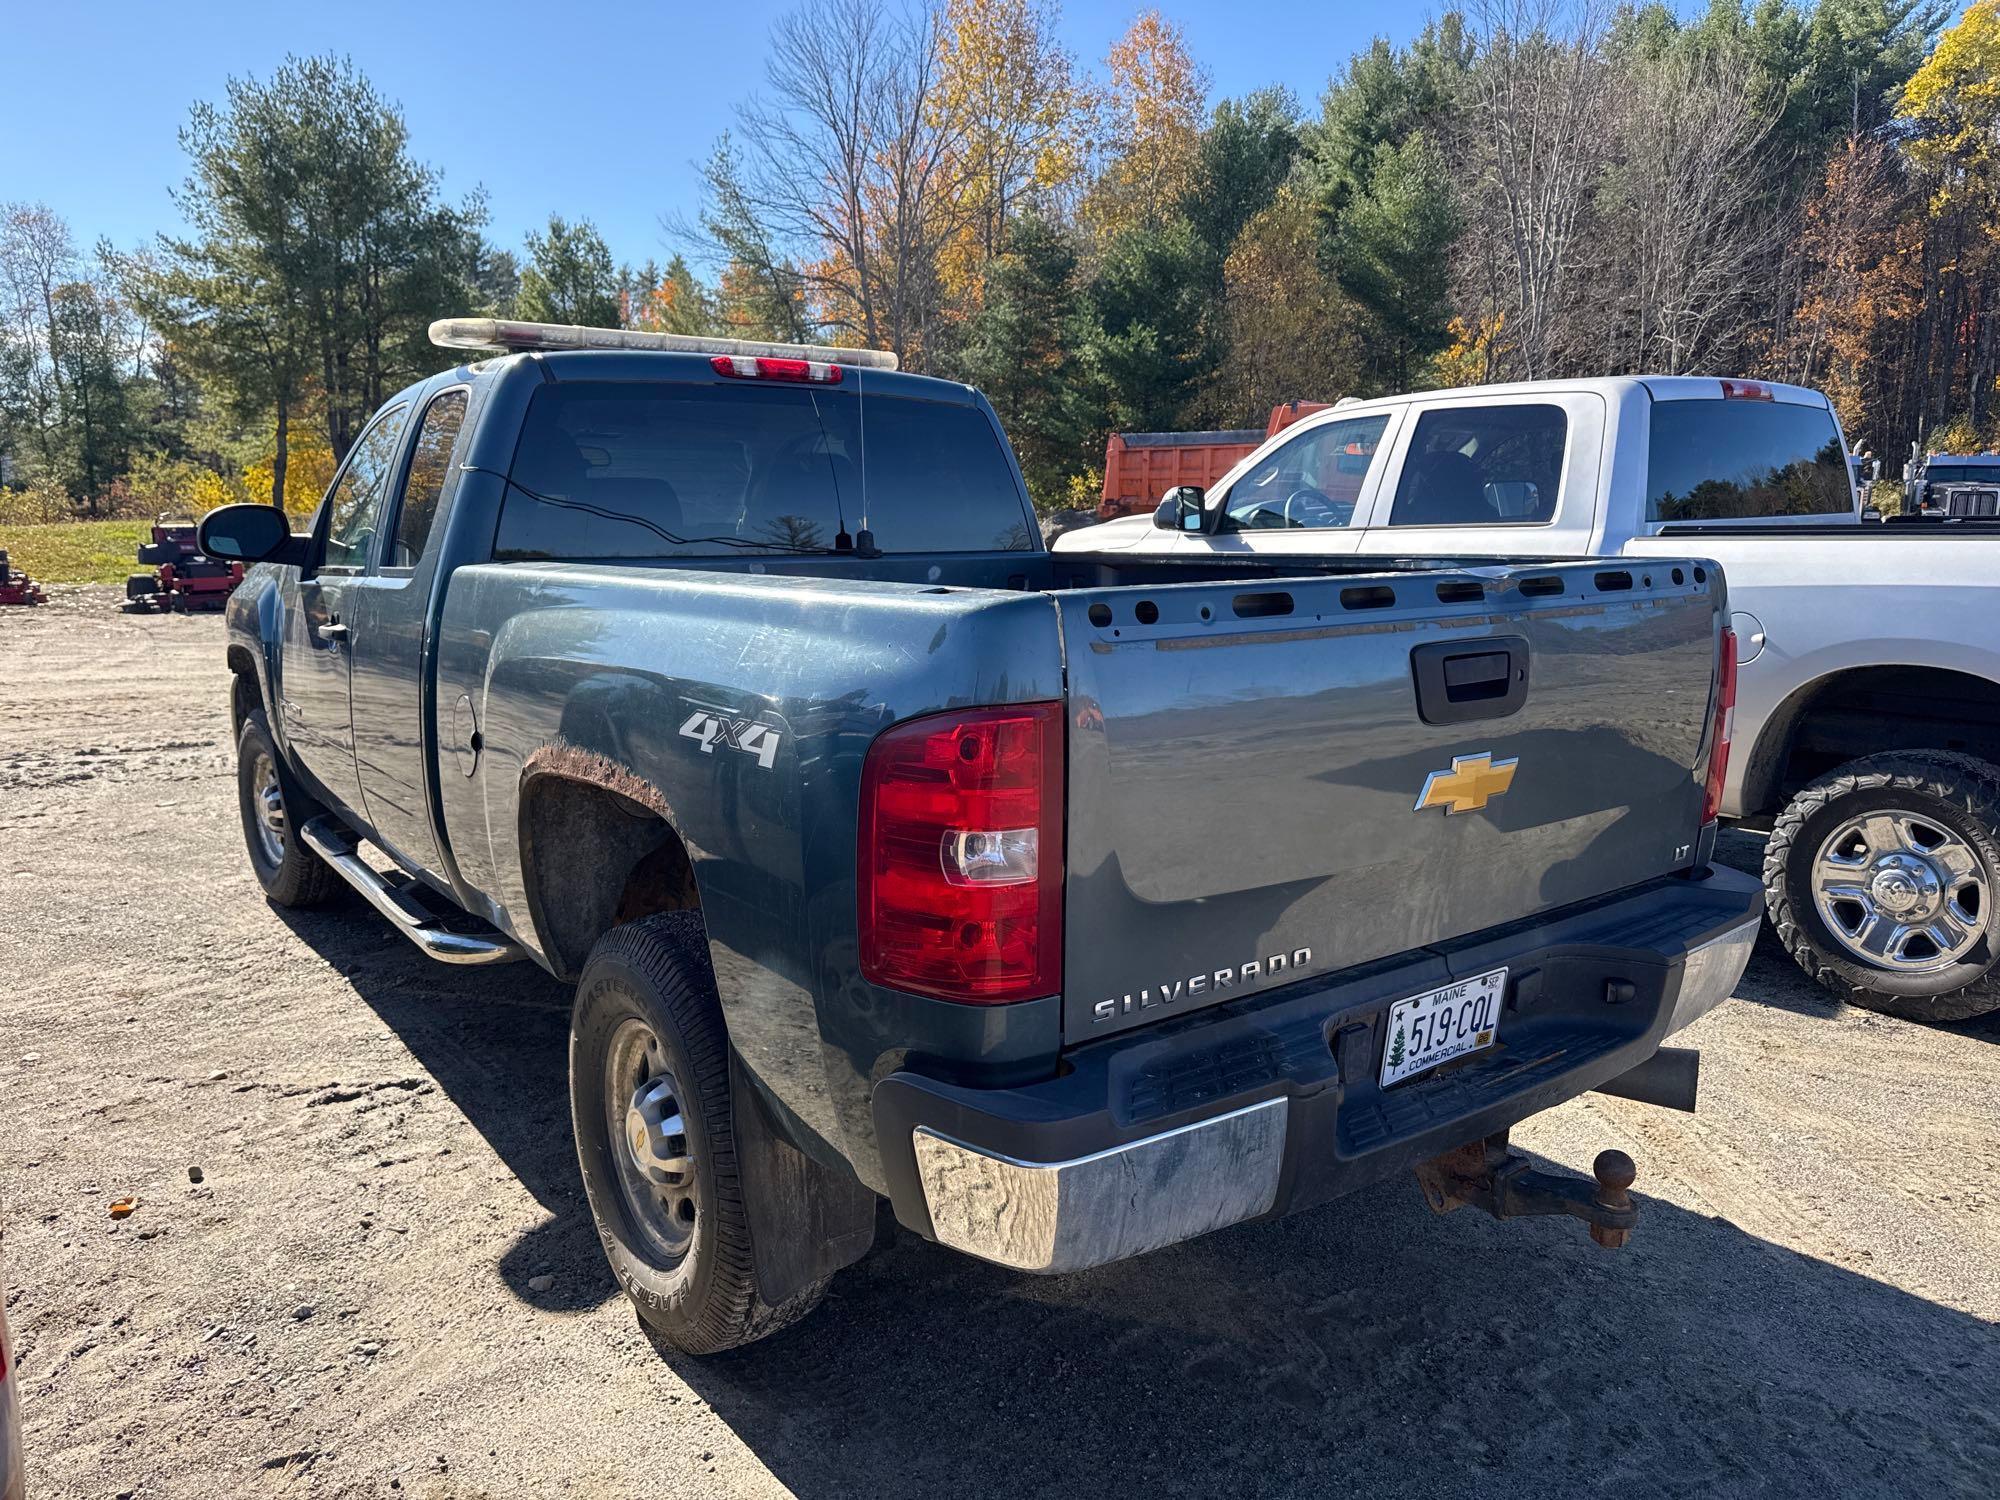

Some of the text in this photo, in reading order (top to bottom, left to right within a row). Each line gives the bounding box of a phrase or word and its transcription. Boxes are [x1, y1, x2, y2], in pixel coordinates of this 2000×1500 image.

[1674, 844, 1690, 862] LT
[1092, 946, 1312, 1024] SILVERADO
[1432, 985, 1468, 1007] MAINE
[1409, 1042, 1468, 1072] COMMERCIAL
